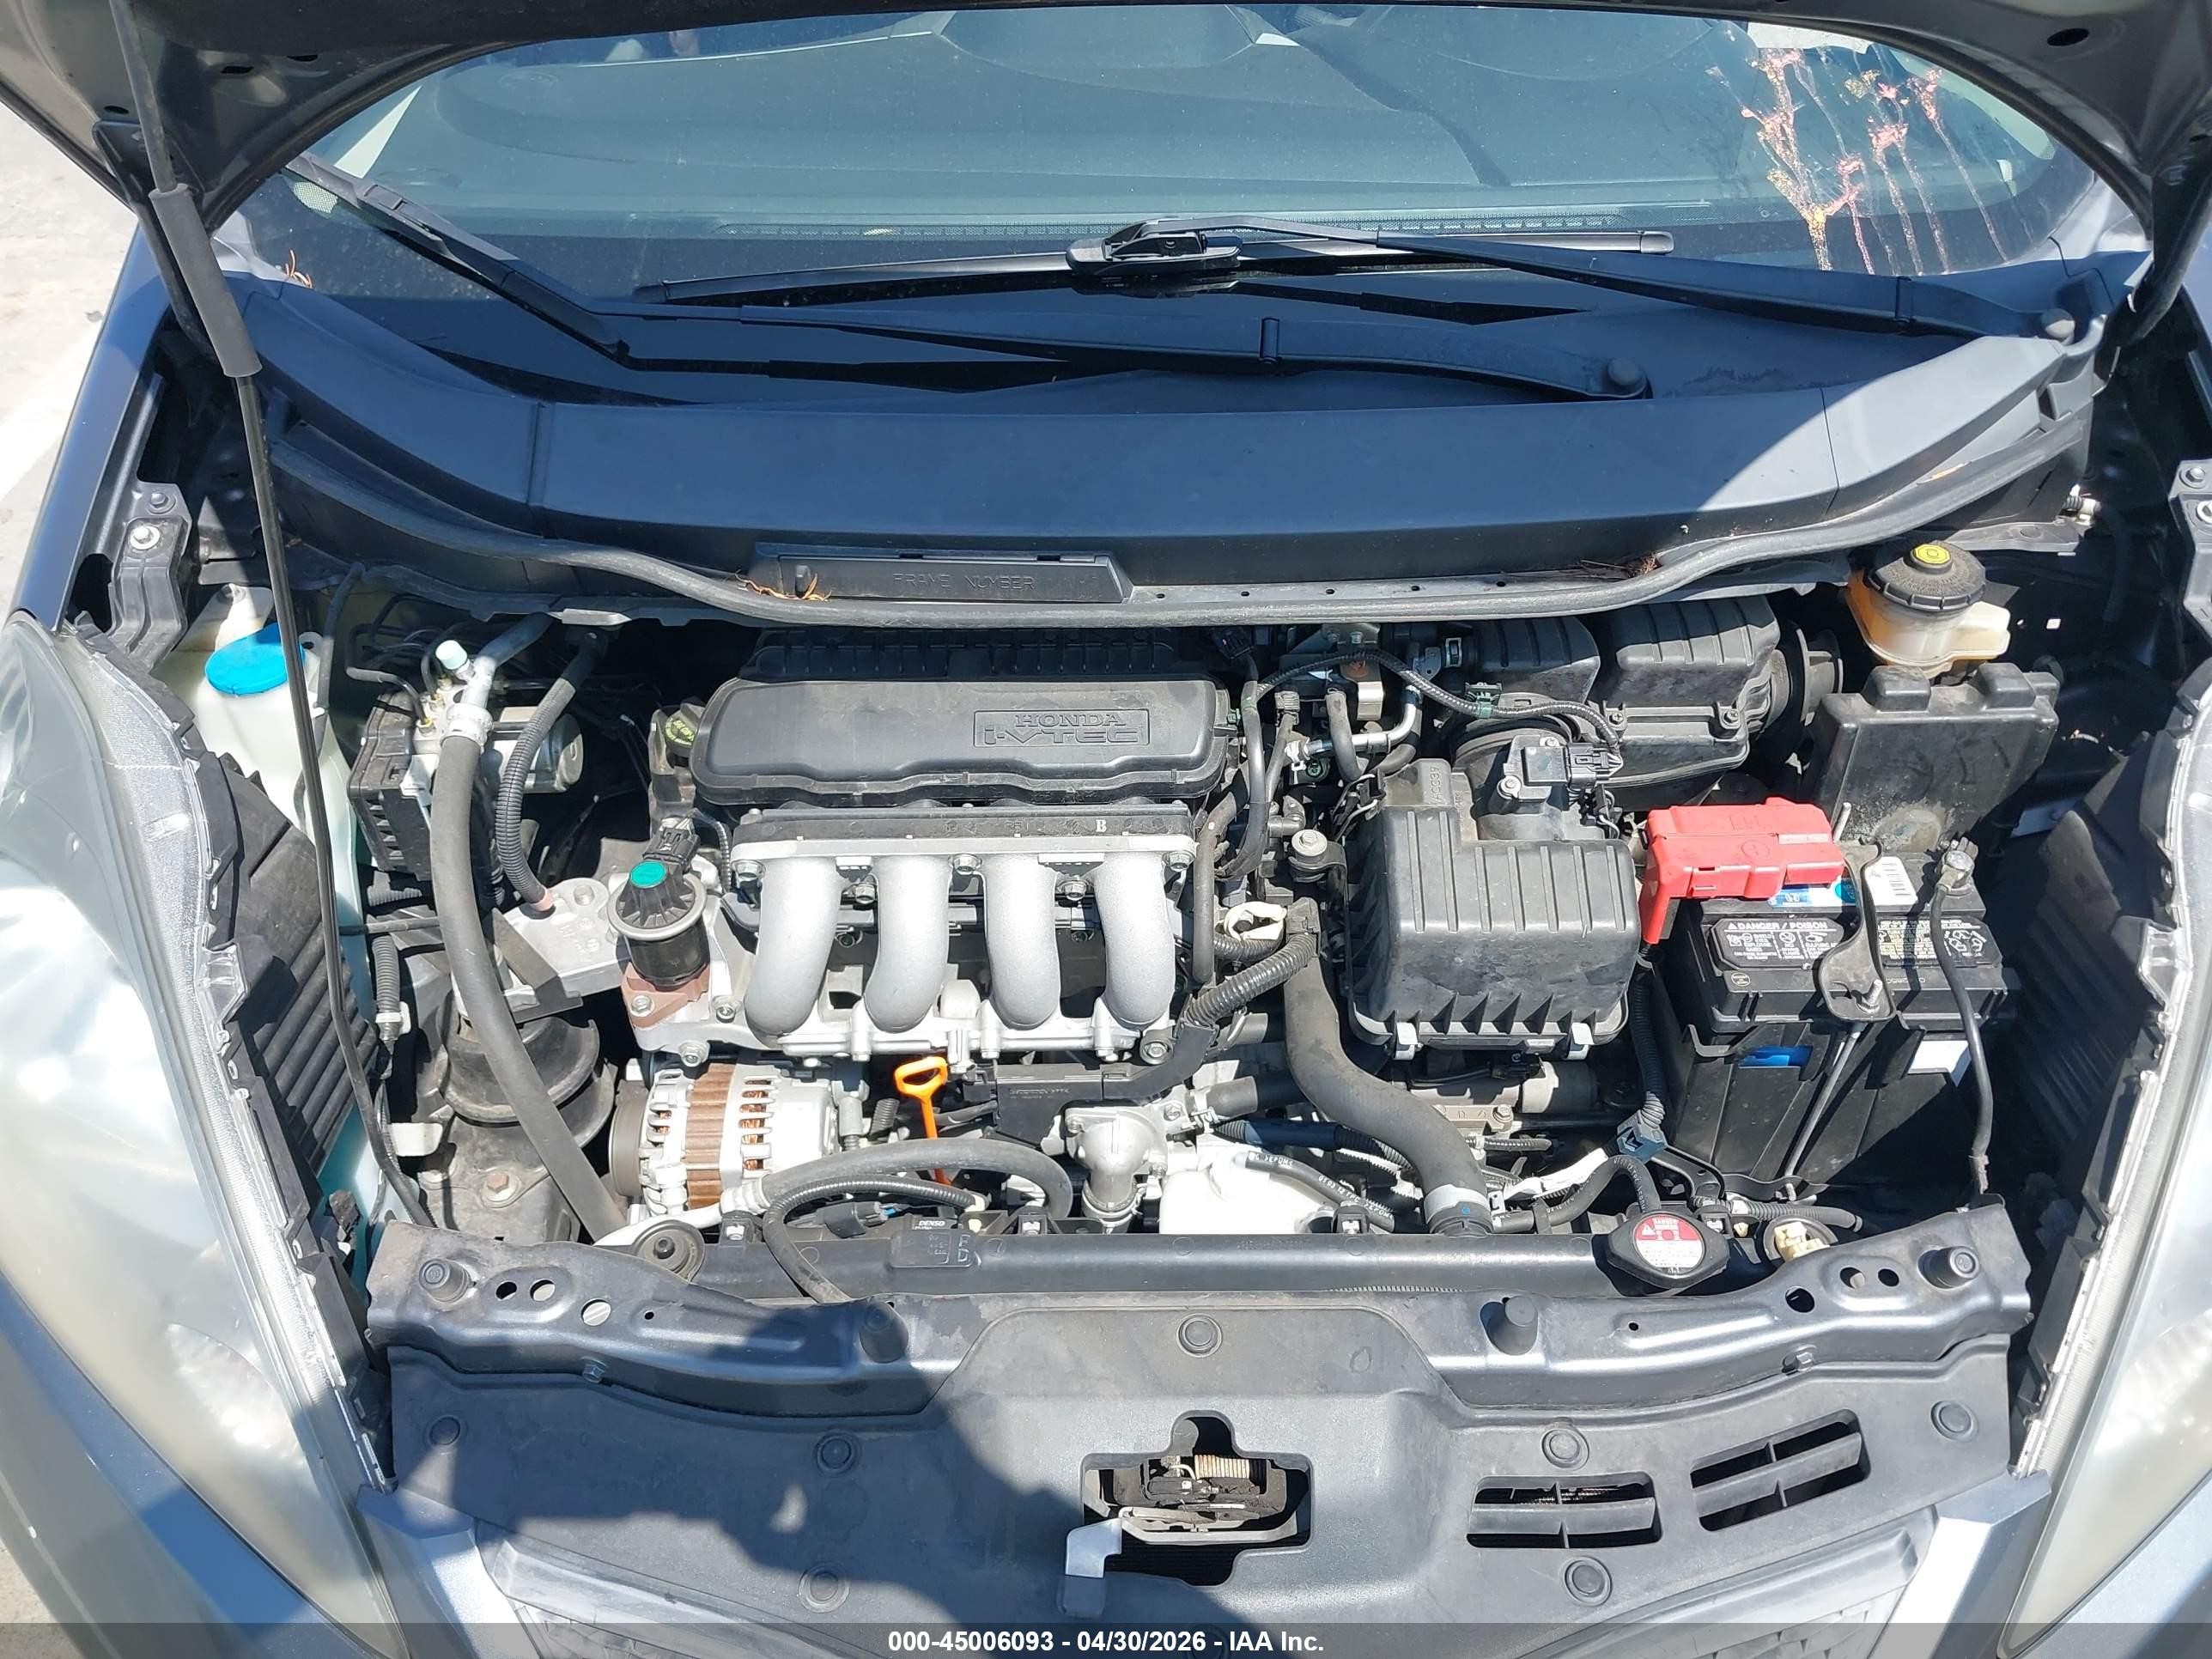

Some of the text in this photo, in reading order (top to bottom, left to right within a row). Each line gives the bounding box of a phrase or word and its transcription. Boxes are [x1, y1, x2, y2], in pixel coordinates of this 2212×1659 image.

[892, 573, 1036, 590] FRAME NUMBER
[1014, 714, 1127, 728] HONDA
[983, 727, 1139, 745] i-VTEC
[1737, 921, 1780, 930] DANGER
[1789, 921, 1828, 930] POISON
